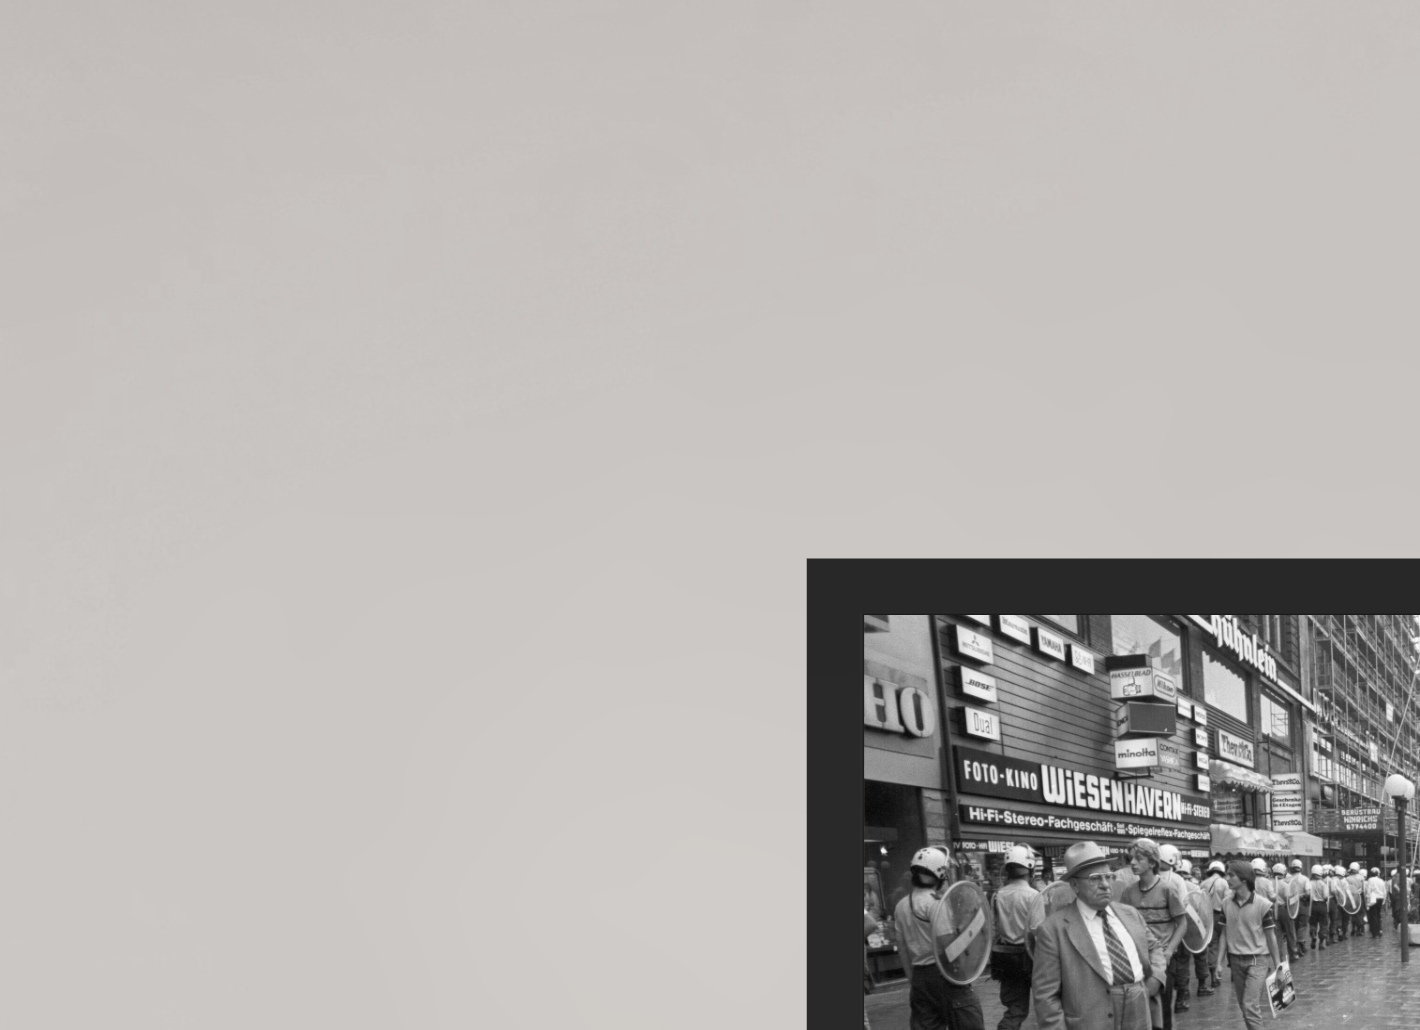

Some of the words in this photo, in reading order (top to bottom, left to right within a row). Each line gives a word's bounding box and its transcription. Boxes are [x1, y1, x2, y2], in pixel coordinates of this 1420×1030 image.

[1041, 634, 1063, 654] YAMAHA
[1111, 669, 1151, 679] HASSELBLAD
[965, 678, 995, 692] BOSE
[1157, 679, 1174, 693] Nikon
[974, 712, 994, 735] Dual
[1118, 747, 1156, 759] minolta
[1160, 743, 1179, 754] CONTAX
[969, 806, 1114, 833] Hi-Fi-Stereo-Fachgeschäft
